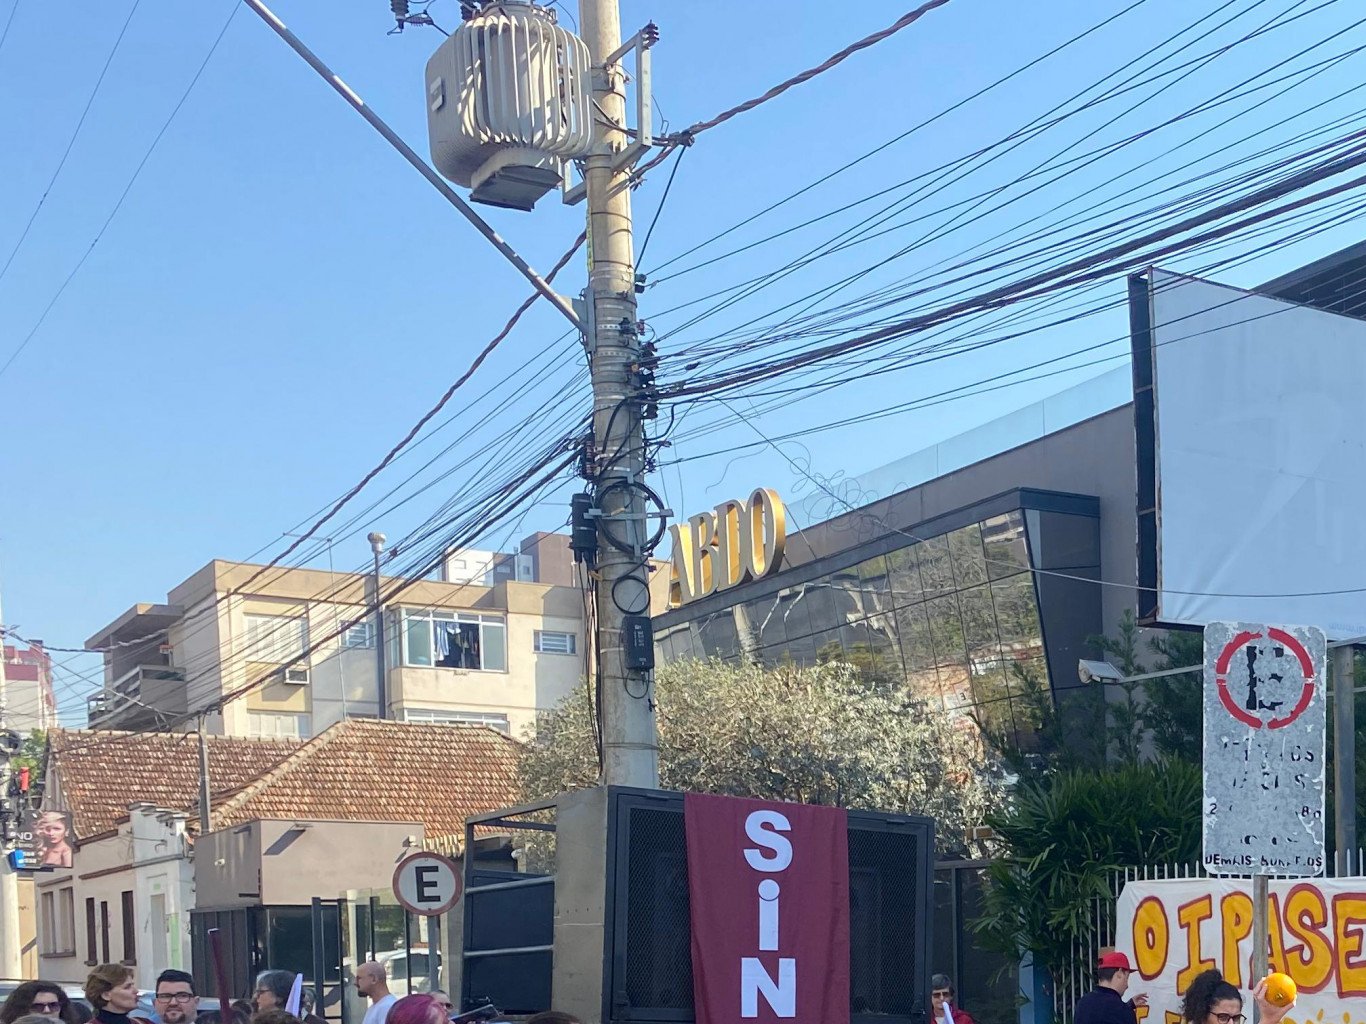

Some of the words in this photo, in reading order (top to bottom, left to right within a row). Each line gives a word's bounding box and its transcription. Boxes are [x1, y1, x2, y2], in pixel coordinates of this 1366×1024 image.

[668, 488, 785, 606] ABDO
[415, 866, 441, 902] E
[1133, 896, 1169, 981] O
